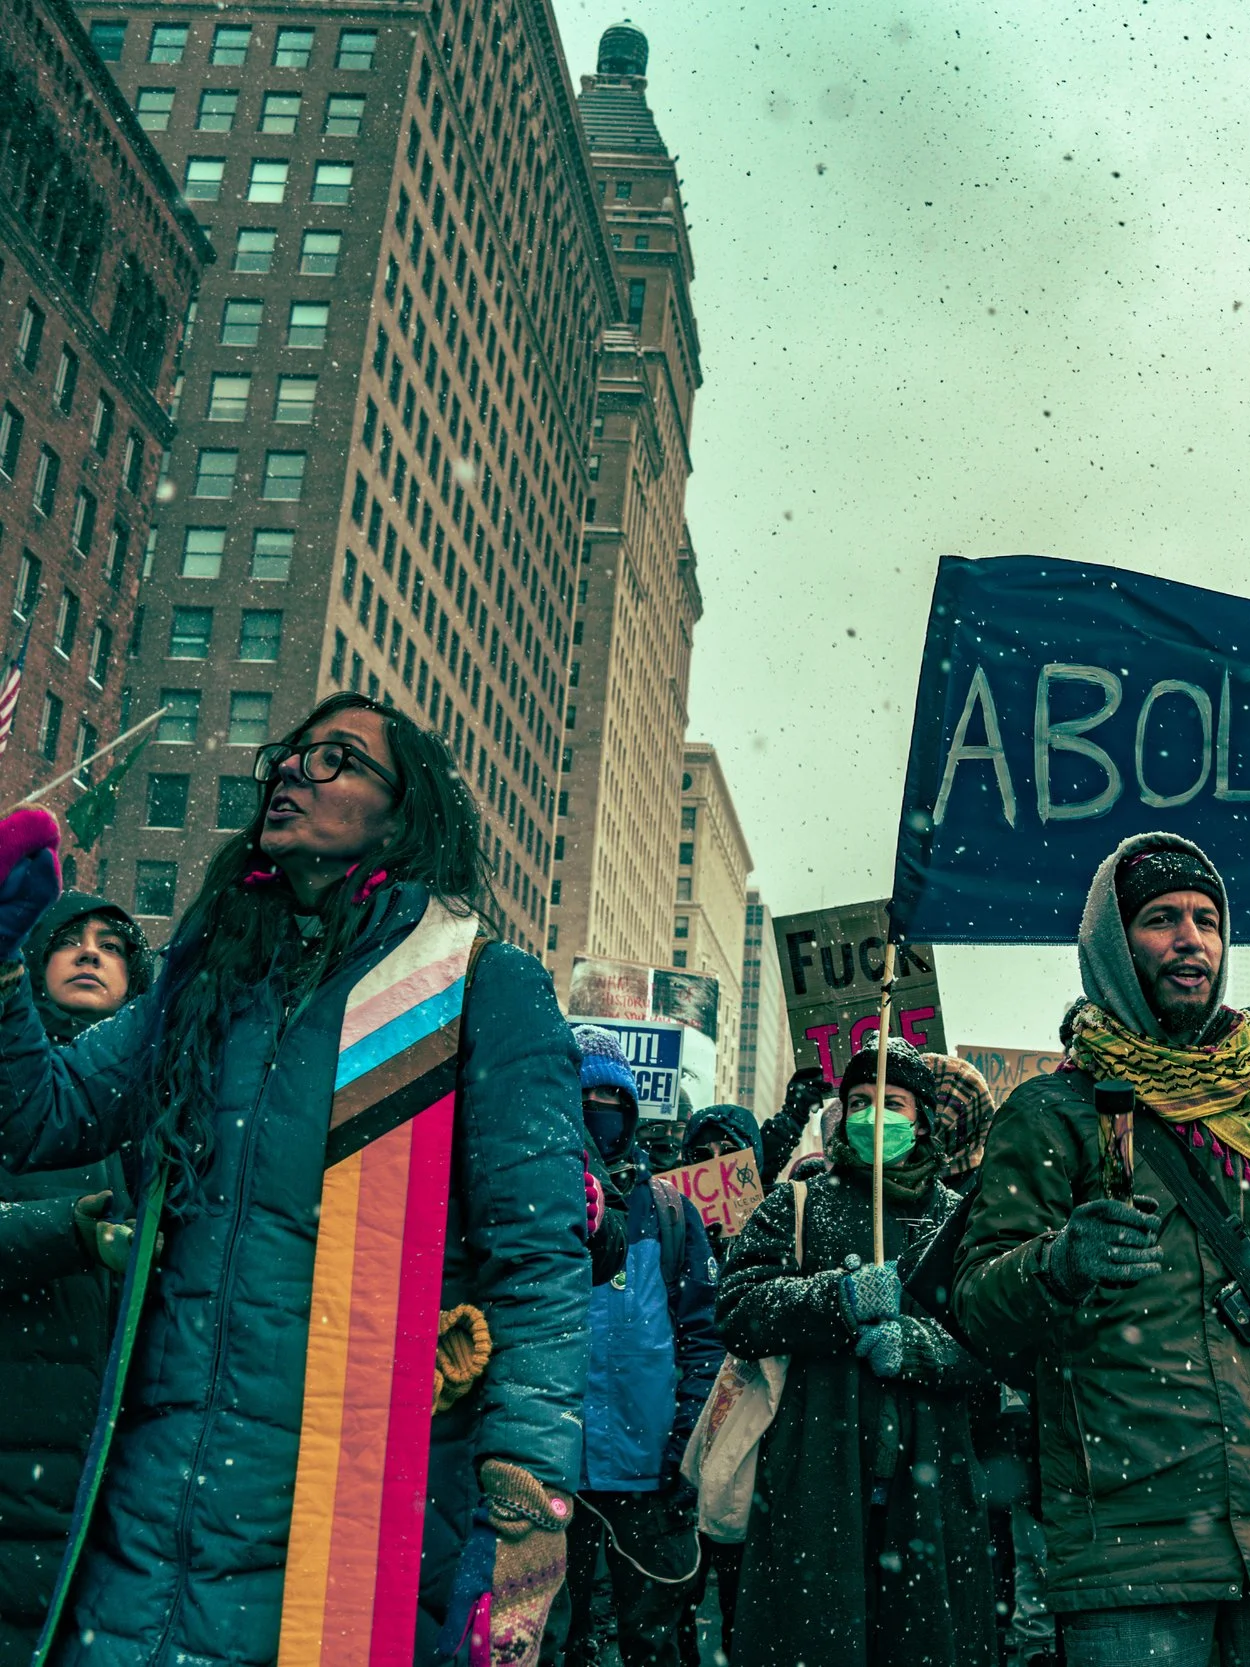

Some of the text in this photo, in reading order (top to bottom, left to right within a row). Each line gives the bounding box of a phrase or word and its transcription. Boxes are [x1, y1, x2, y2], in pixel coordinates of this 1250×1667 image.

[786, 929, 933, 995] FUCK
[632, 1070, 673, 1103] CE!
[655, 1158, 743, 1203] UCK
